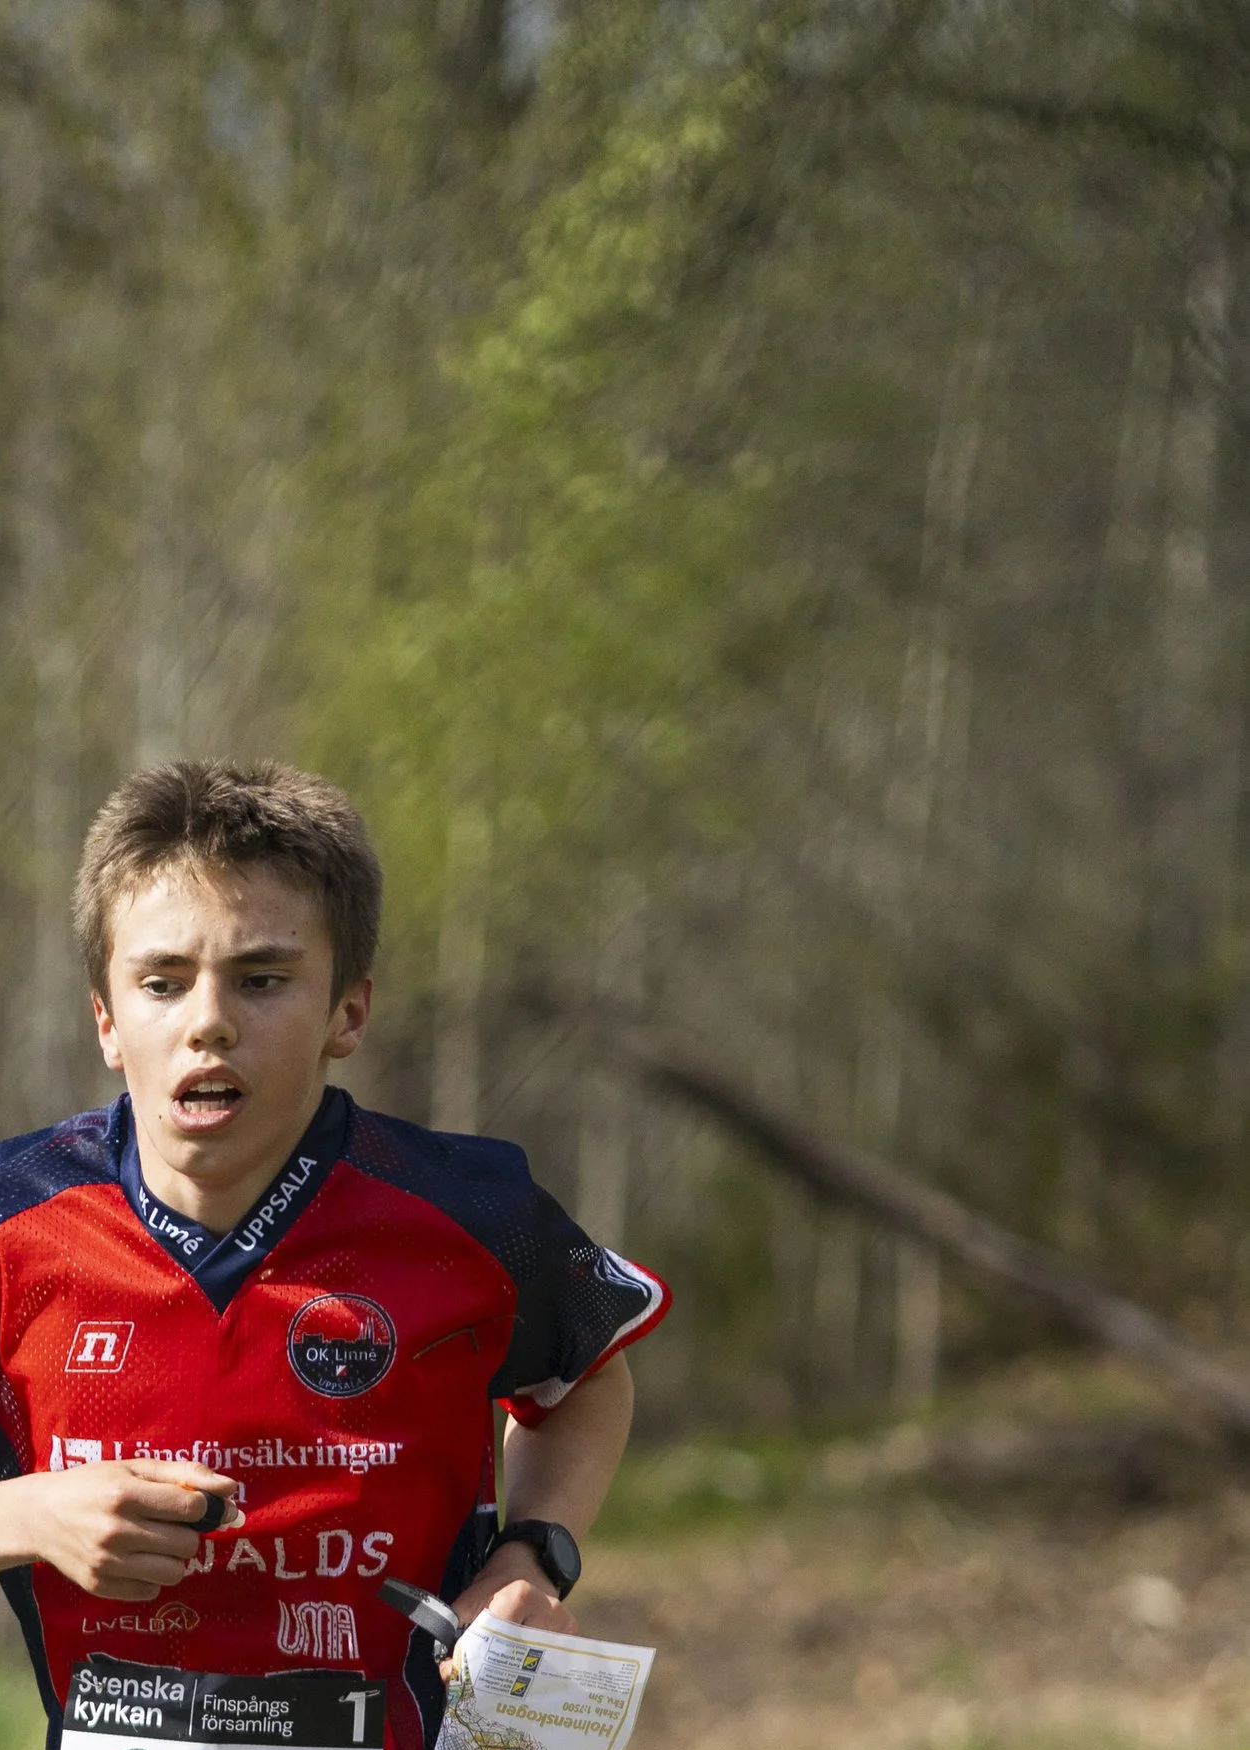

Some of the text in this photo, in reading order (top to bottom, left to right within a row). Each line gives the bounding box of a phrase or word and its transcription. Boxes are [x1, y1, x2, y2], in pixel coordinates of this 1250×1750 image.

[235, 1156, 318, 1252] UPPSALA
[306, 1347, 377, 1362] OK Linné
[318, 1377, 364, 1391] UPPSALA
[114, 1437, 403, 1475] Länsförsäkringar
[276, 1600, 359, 1660] UMA
[79, 1669, 185, 1701] Svenska
[588, 1692, 625, 1709] Ekv. 5m
[74, 1695, 163, 1728] kyrkan
[203, 1695, 290, 1717] Finspångs
[345, 1691, 367, 1742] 1
[495, 1702, 613, 1736] Holmenskogen
[562, 1701, 620, 1720] Skala 1:7500
[201, 1715, 294, 1738] församling
